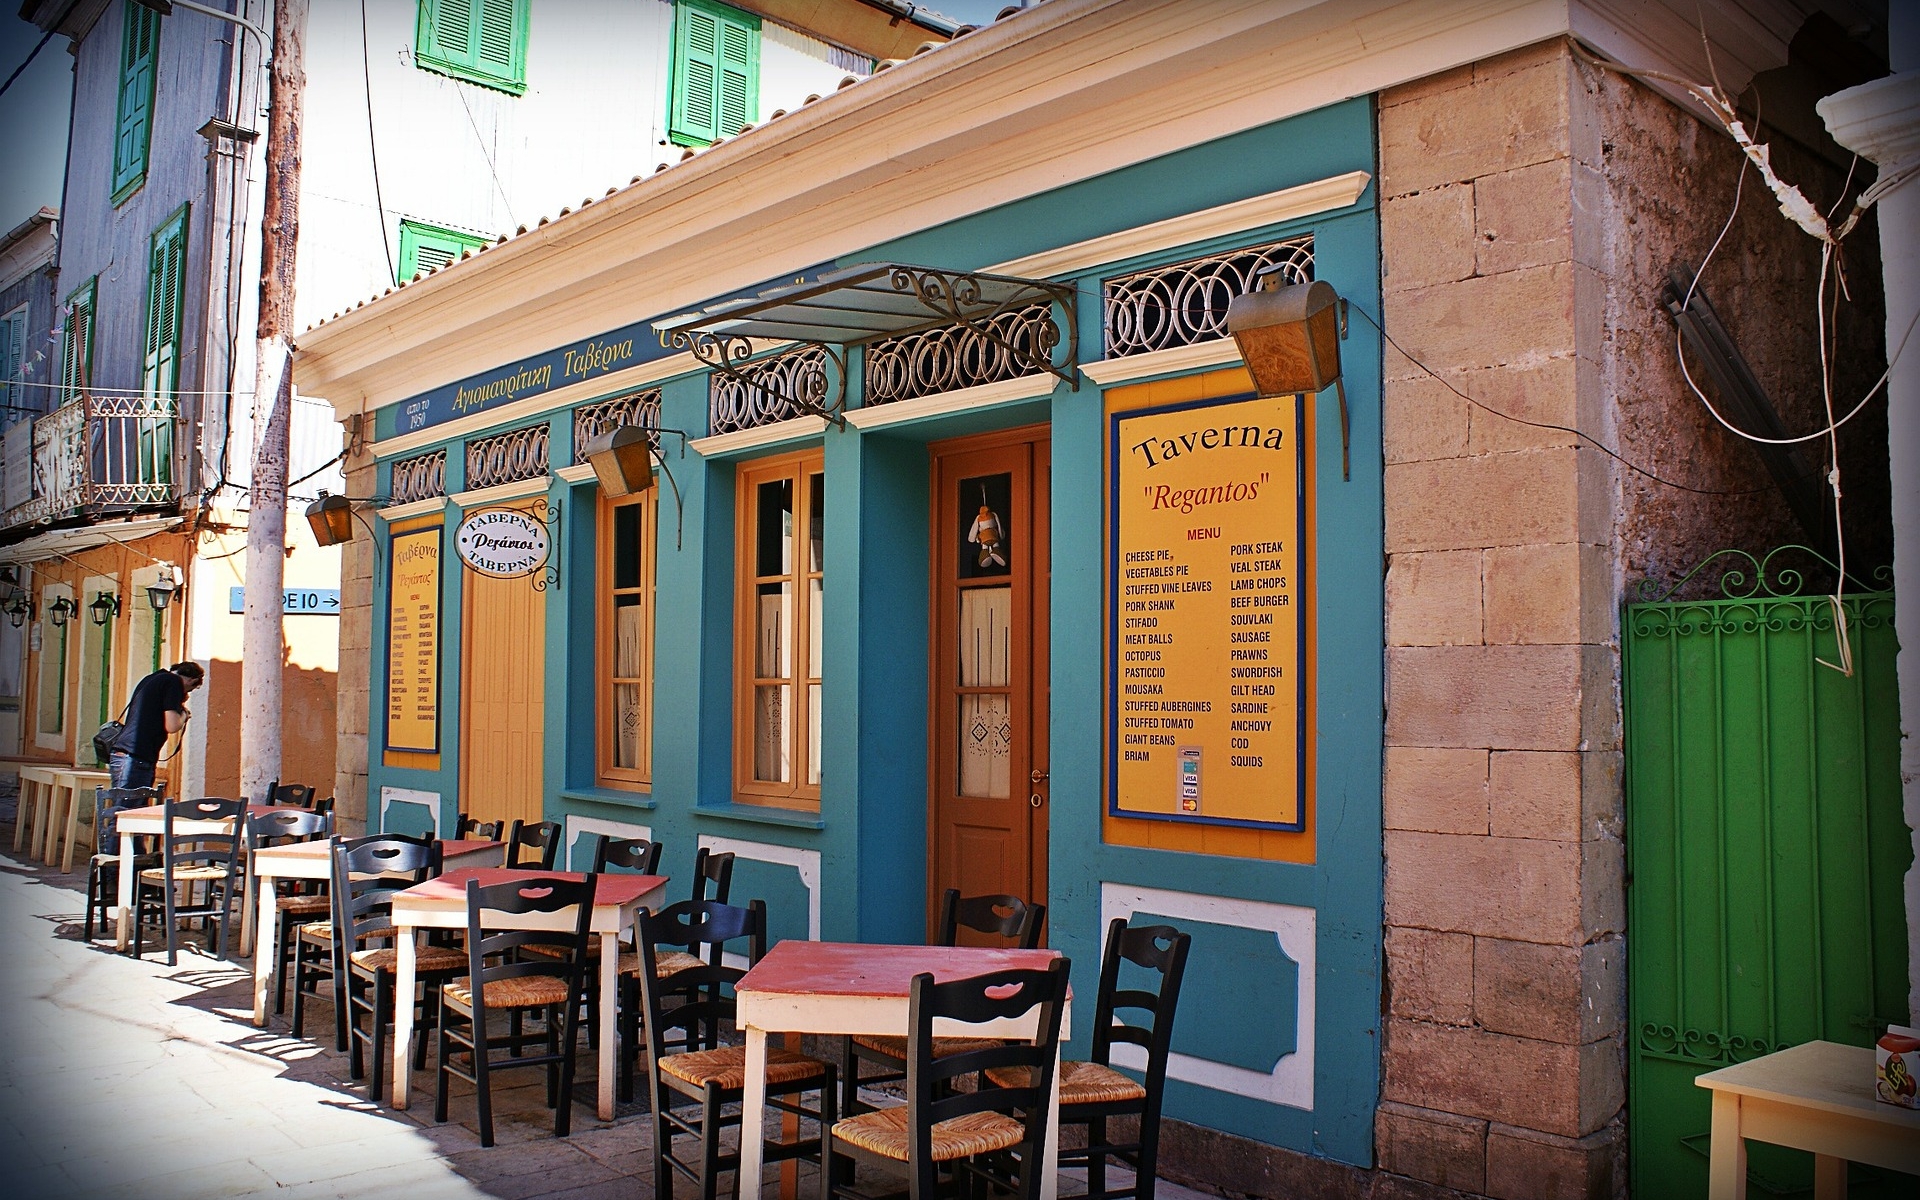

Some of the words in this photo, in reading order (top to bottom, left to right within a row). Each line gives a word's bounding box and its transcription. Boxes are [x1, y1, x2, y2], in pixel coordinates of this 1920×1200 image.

[564, 340, 632, 378] Ταβέρνα
[410, 412, 425, 429] 1950
[1132, 426, 1283, 469] Taverna
[1144, 473, 1269, 514] "Regantos"
[467, 514, 538, 538] ΤΑΒΕΡΝΑ
[1187, 527, 1221, 540] MENU
[396, 542, 437, 565] Ταβέρνα
[1231, 543, 1253, 556] PORK
[1256, 542, 1283, 554] STEAK
[470, 551, 537, 572] ΤΑΒΕΡΝΑ
[1126, 551, 1155, 562] CHEESE
[1126, 567, 1173, 578] VEGETABLES
[1176, 565, 1188, 576] PIE
[1231, 561, 1251, 573] VEAL
[1254, 560, 1281, 571] STEAK
[1126, 584, 1159, 595] STUFFED
[1162, 583, 1179, 593] VINE
[1182, 581, 1211, 592] LEAVES
[1231, 579, 1253, 590] LAMB
[1257, 577, 1286, 589] CHOPS
[1125, 600, 1147, 612] PORK
[1149, 598, 1175, 611] SHANK
[1231, 597, 1251, 609] BEEF
[1254, 595, 1289, 608] BURGER
[1125, 618, 1157, 628] STIFADO
[1231, 614, 1273, 625] SOUVLAKI
[1125, 635, 1146, 645] MEAT
[1149, 634, 1173, 644] BALLS
[1231, 632, 1270, 643] SAUSAGE
[1125, 651, 1161, 661] OCTOPUS
[1231, 650, 1267, 660] PRAWNS
[1125, 668, 1165, 678] PASTICCIO
[1231, 667, 1282, 678] SWORDFISH
[1125, 685, 1163, 694] MOUSAKA
[1231, 685, 1249, 696] GILT
[1252, 685, 1275, 695] HEAD
[1125, 701, 1158, 711] STUFFED
[1161, 702, 1212, 712] AUBERGINES
[1231, 703, 1268, 713] SARDINE
[1125, 718, 1158, 728] STUFFED
[1161, 719, 1194, 729] TOMATO
[1231, 721, 1272, 731] ANCHOVY
[1125, 734, 1147, 745] GIANT
[1150, 735, 1175, 746] BEANS
[1231, 738, 1249, 749] COD
[1125, 751, 1149, 761] BRIAM
[1231, 756, 1263, 767] SQUIDS
[1887, 1060, 1908, 1090] Life
